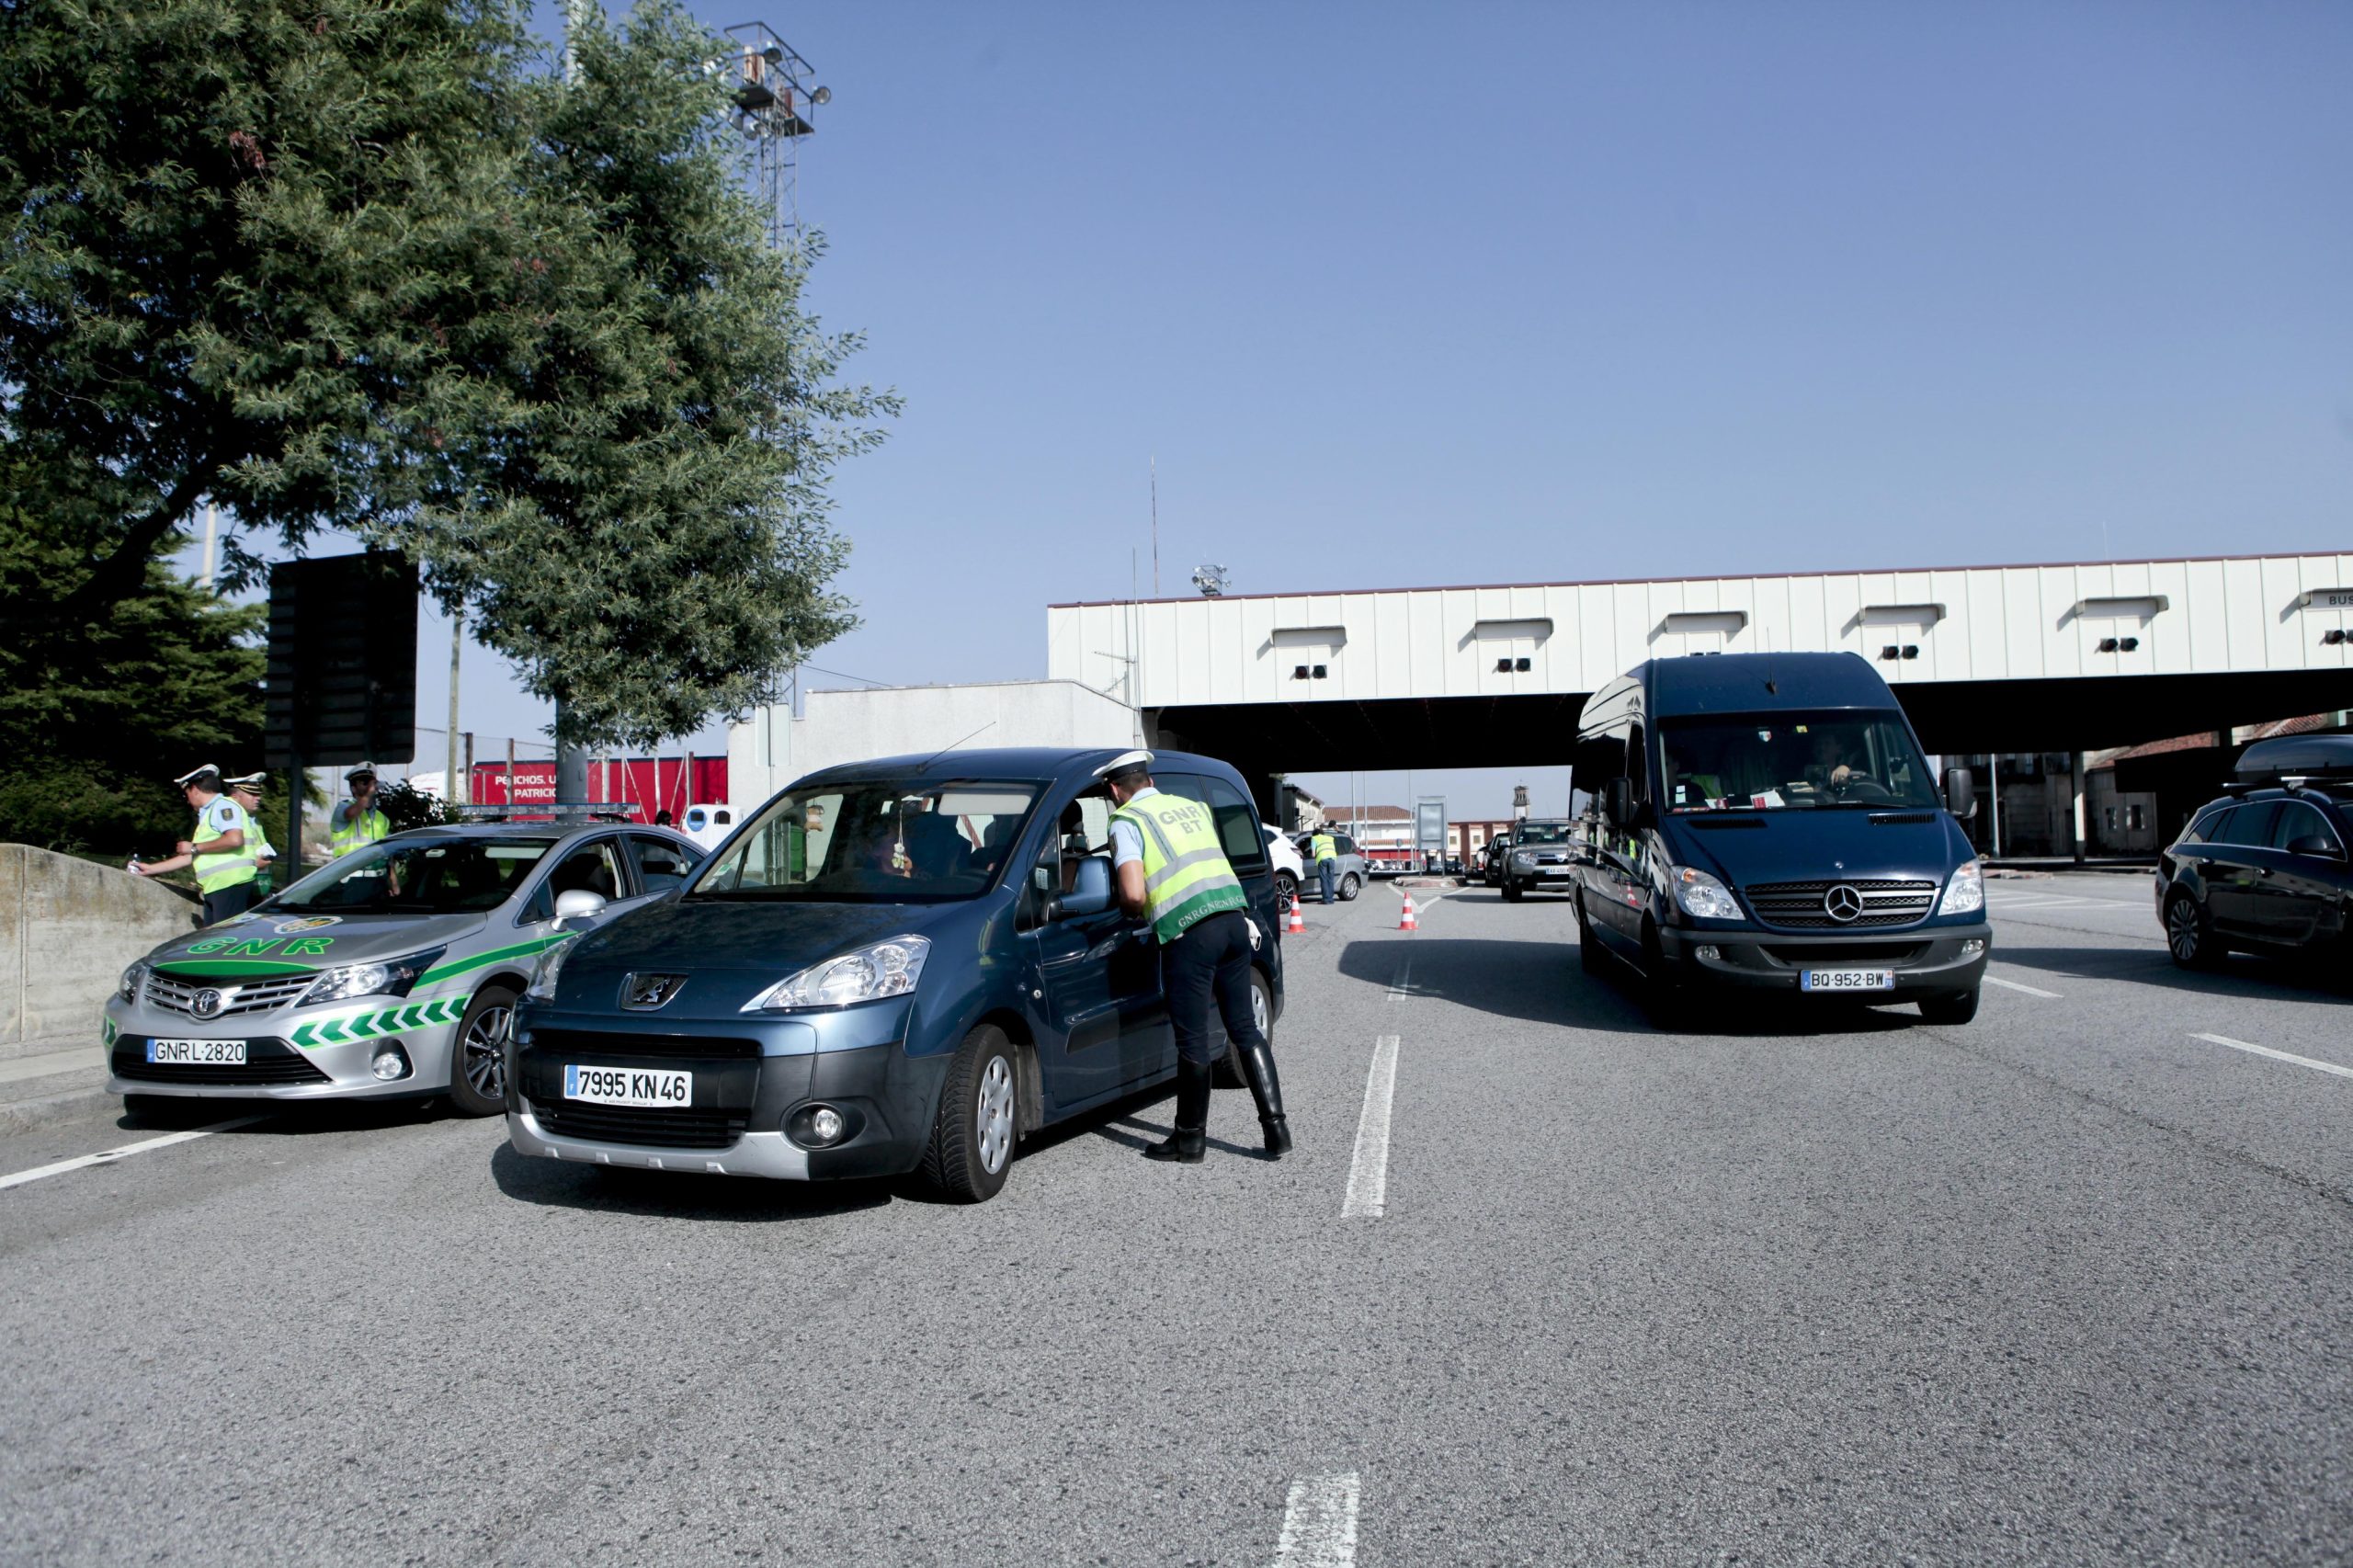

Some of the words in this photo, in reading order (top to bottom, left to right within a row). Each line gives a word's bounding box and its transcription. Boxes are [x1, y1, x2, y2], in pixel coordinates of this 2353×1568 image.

[1158, 806, 1202, 824] GNR
[1180, 820, 1202, 834] BT
[187, 937, 334, 955] GNR
[579, 1071, 626, 1097] 7995
[631, 1074, 657, 1099] KN
[660, 1075, 686, 1101] 46
